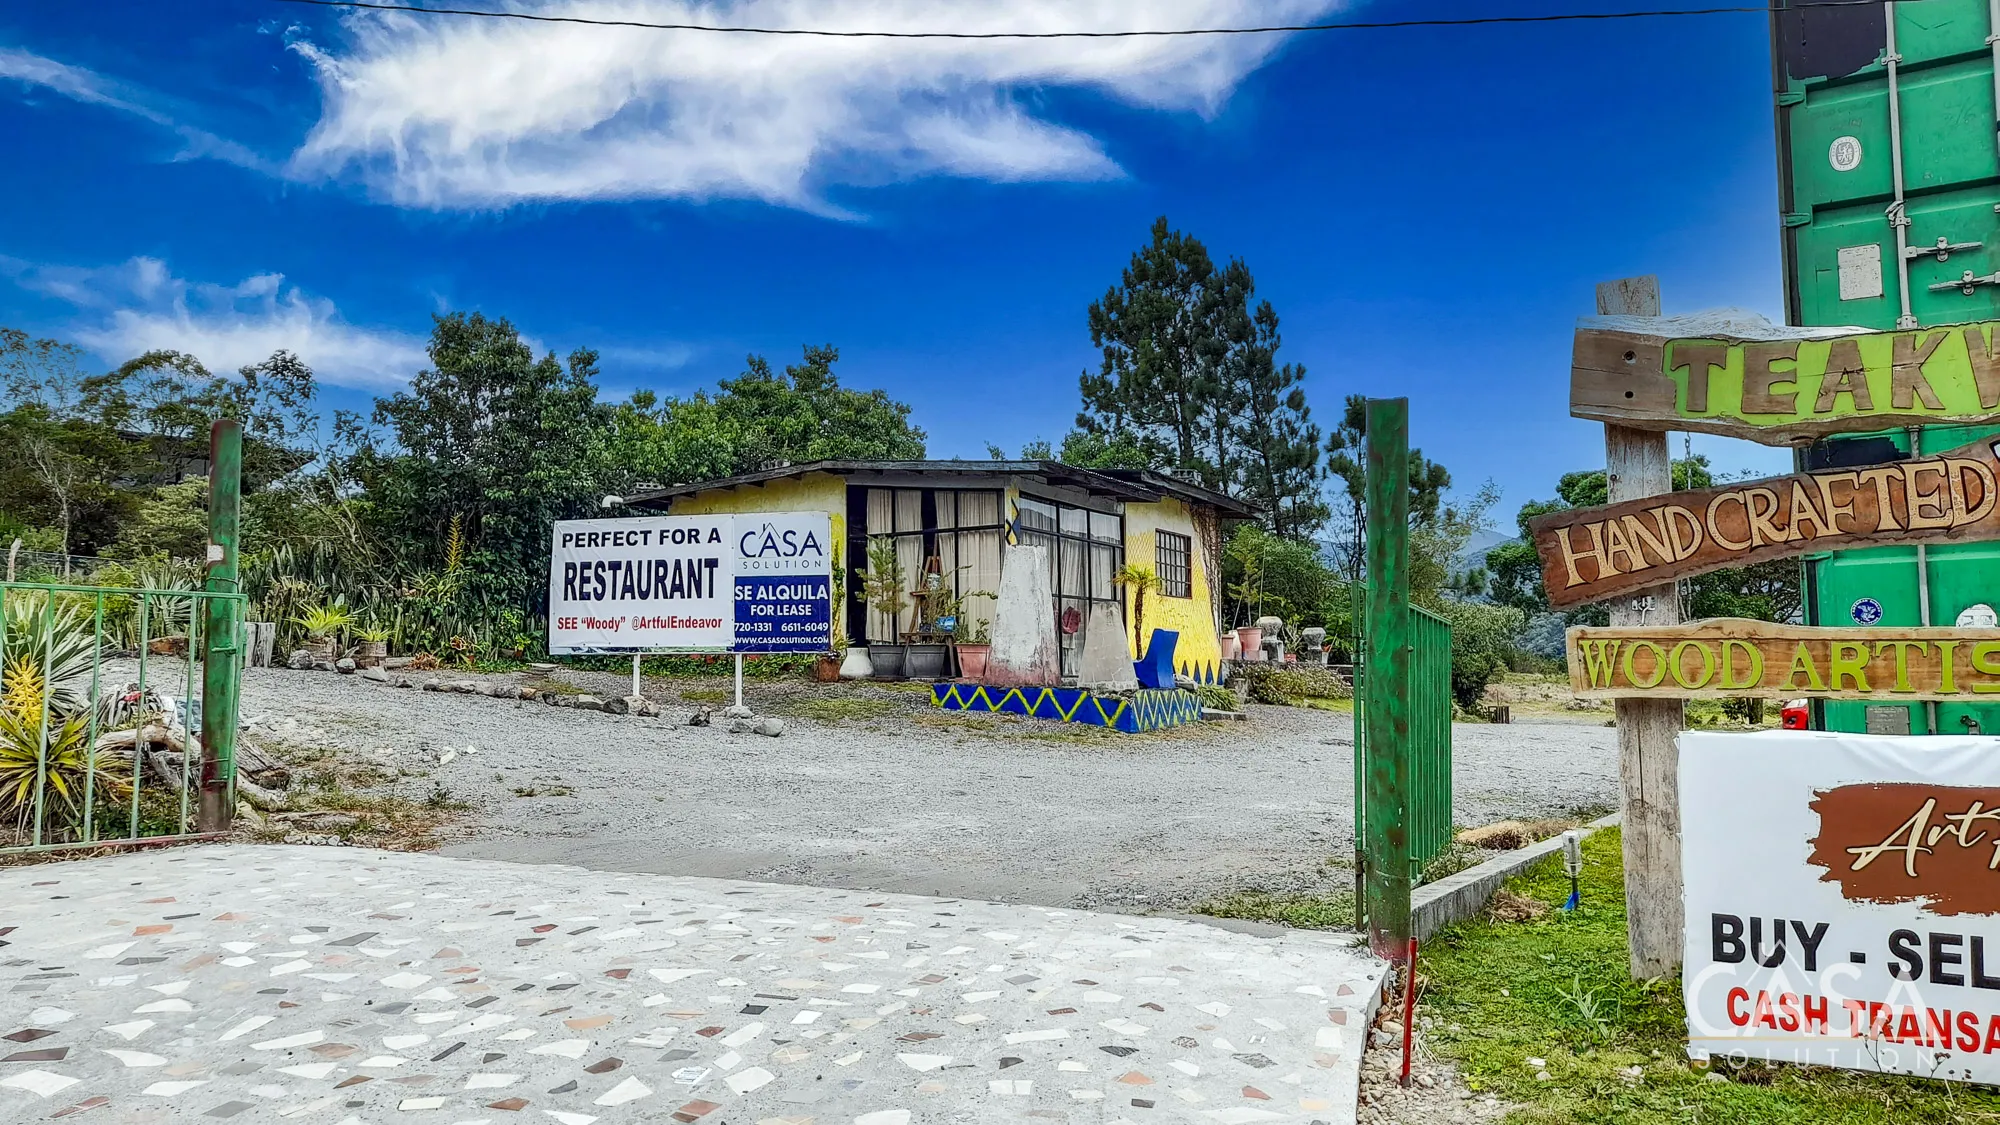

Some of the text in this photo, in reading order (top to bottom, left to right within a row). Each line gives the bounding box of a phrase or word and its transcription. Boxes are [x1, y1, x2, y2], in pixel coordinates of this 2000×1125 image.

[561, 527, 722, 548] PERFECT FOR A
[740, 529, 823, 558] CASA
[743, 560, 821, 569] SOLUTION
[563, 557, 719, 601] RESTAURANT
[734, 585, 828, 601] SE ALQUILA
[750, 604, 812, 616] FOR LEASE
[557, 617, 578, 630] SEE
[631, 615, 723, 631] @ArtfulEndeavor
[735, 622, 829, 632] 720-1331 6611-6049
[1580, 638, 1763, 690] WOOD
[1846, 797, 2000, 877] Art
[1711, 912, 1830, 972] BUY
[1887, 929, 2000, 991] SEL
[1727, 987, 1829, 1035] CASH
